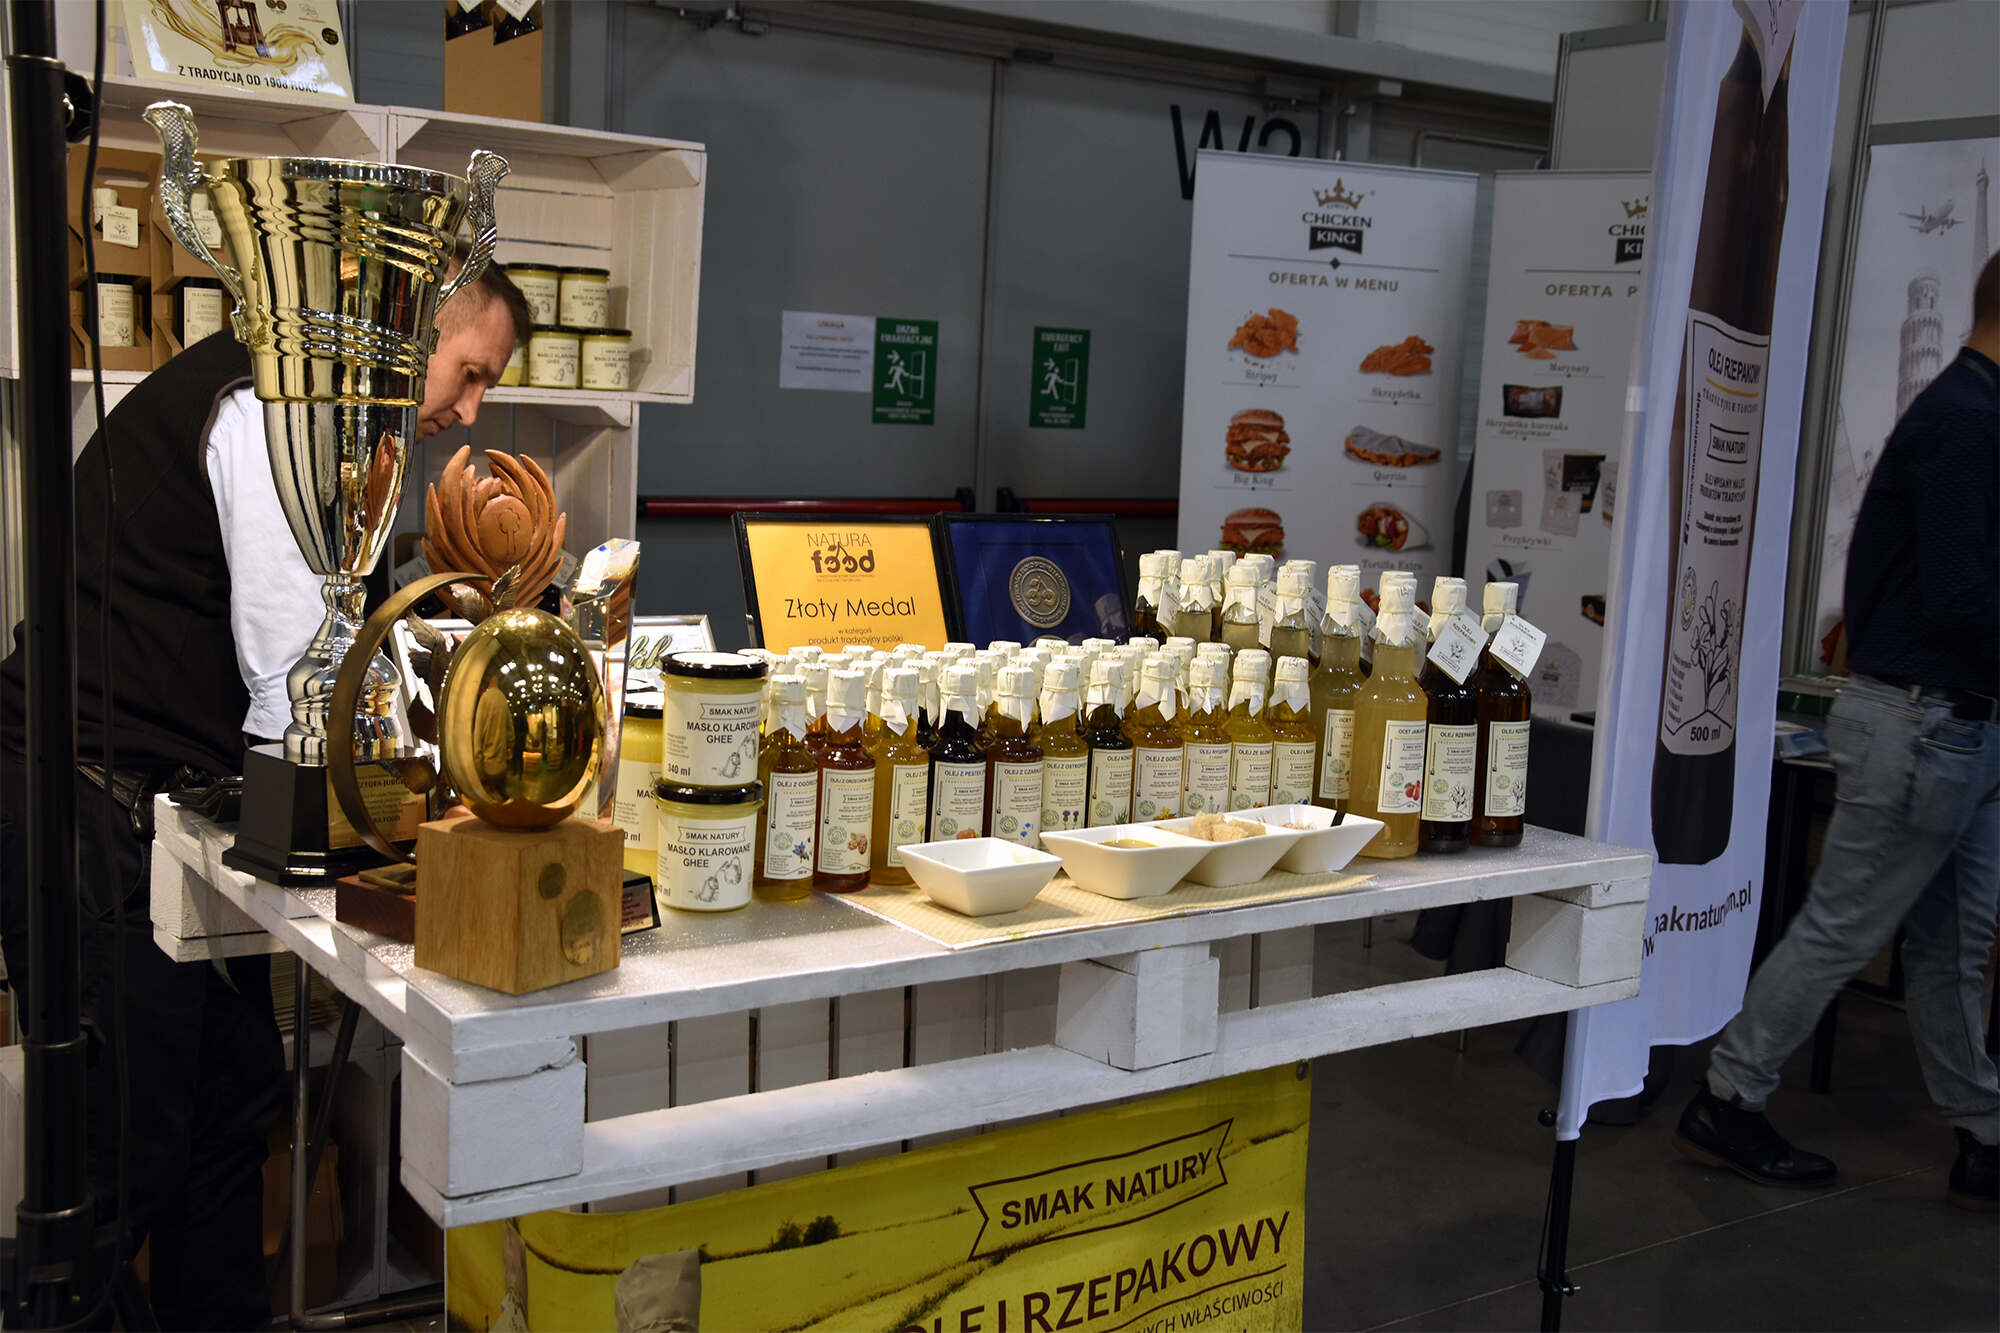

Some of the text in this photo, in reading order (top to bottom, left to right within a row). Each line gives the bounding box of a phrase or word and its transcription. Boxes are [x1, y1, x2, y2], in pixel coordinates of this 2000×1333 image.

[178, 65, 186, 77] Z
[187, 66, 244, 86] TRADYCJĄ
[246, 73, 261, 86] OD
[1302, 211, 1372, 229] CHICKEN
[1316, 230, 1357, 245] KING
[1268, 271, 1399, 292] OFERTA W MENU
[1545, 284, 1613, 297] OFERTA
[1708, 347, 1725, 375] OLEJ
[806, 532, 872, 548] NATURA
[811, 549, 875, 574] food
[784, 596, 916, 623] Złoty Medal
[808, 633, 904, 646] produkt tradycyjny polski
[709, 706, 757, 716] SMAK NATURY
[686, 721, 721, 733] MASŁO
[1689, 725, 1721, 742] 500 ml
[706, 734, 733, 744] GHEE
[1238, 748, 1252, 756] OLEJ
[680, 766, 691, 777] ml
[944, 769, 959, 777] OLEJ
[776, 780, 792, 788] OLEJ
[792, 780, 798, 788] Z
[630, 833, 641, 842] ml
[685, 831, 740, 841] SMAK NATURY
[667, 842, 751, 857] MASŁO KLAROWANE
[683, 858, 709, 868] GHEE
[664, 887, 671, 897] ml
[1000, 1147, 1213, 1230] SMAK NATURY
[1023, 1210, 1291, 1333] RZEPAKOWY
[1180, 1279, 1285, 1326] WŁAŚCIWOŚCI
